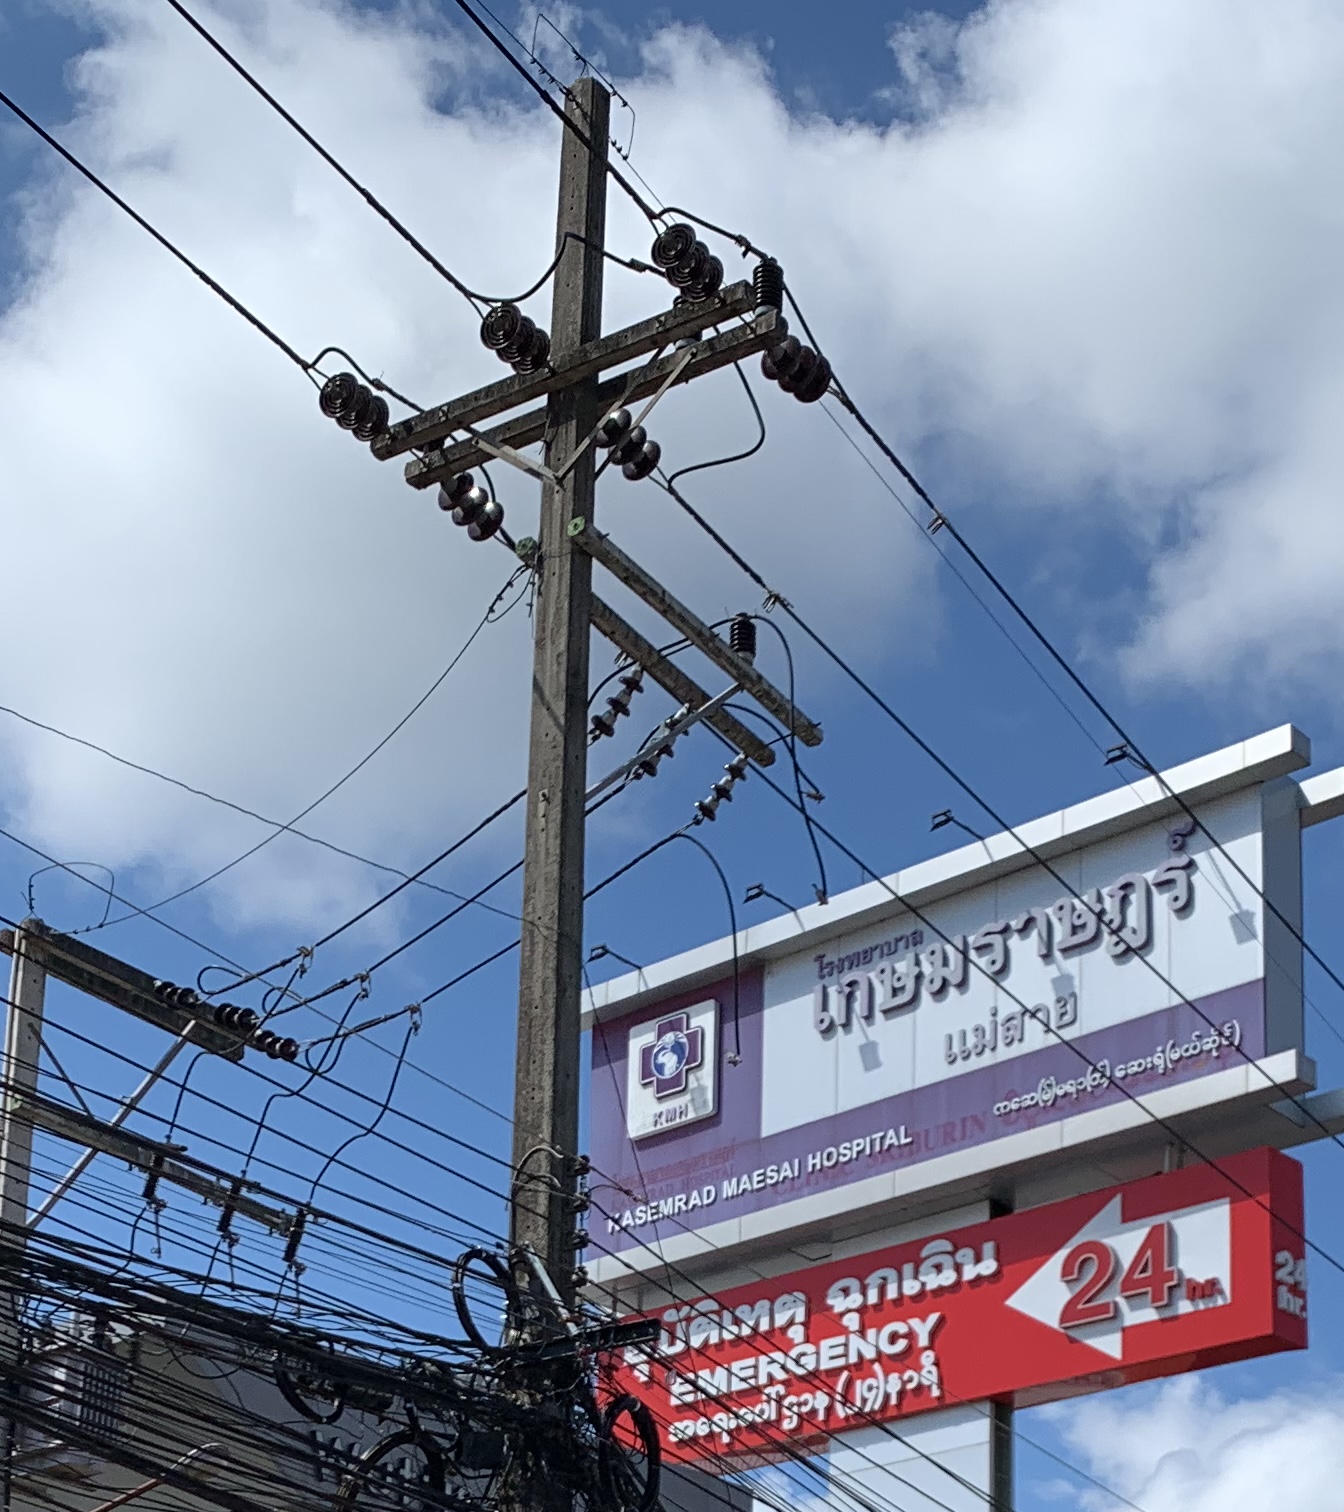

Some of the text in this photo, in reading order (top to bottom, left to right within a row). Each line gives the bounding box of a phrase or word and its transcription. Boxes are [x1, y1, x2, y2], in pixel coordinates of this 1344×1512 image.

[813, 822, 1200, 1038] เกษมราษฎร์
[815, 927, 924, 981] โรงพยาบาล
[943, 991, 1078, 1066] แม่สาย
[653, 1103, 689, 1128] KMH
[606, 1183, 716, 1234] KASEMRAD
[720, 1157, 801, 1200] MAESAI
[807, 1124, 913, 1175] HOSPITAL
[826, 1228, 1000, 1334] ฉุกเฉิน
[1059, 1221, 1180, 1330] 24
[669, 1310, 945, 1408] EMERGENCY
